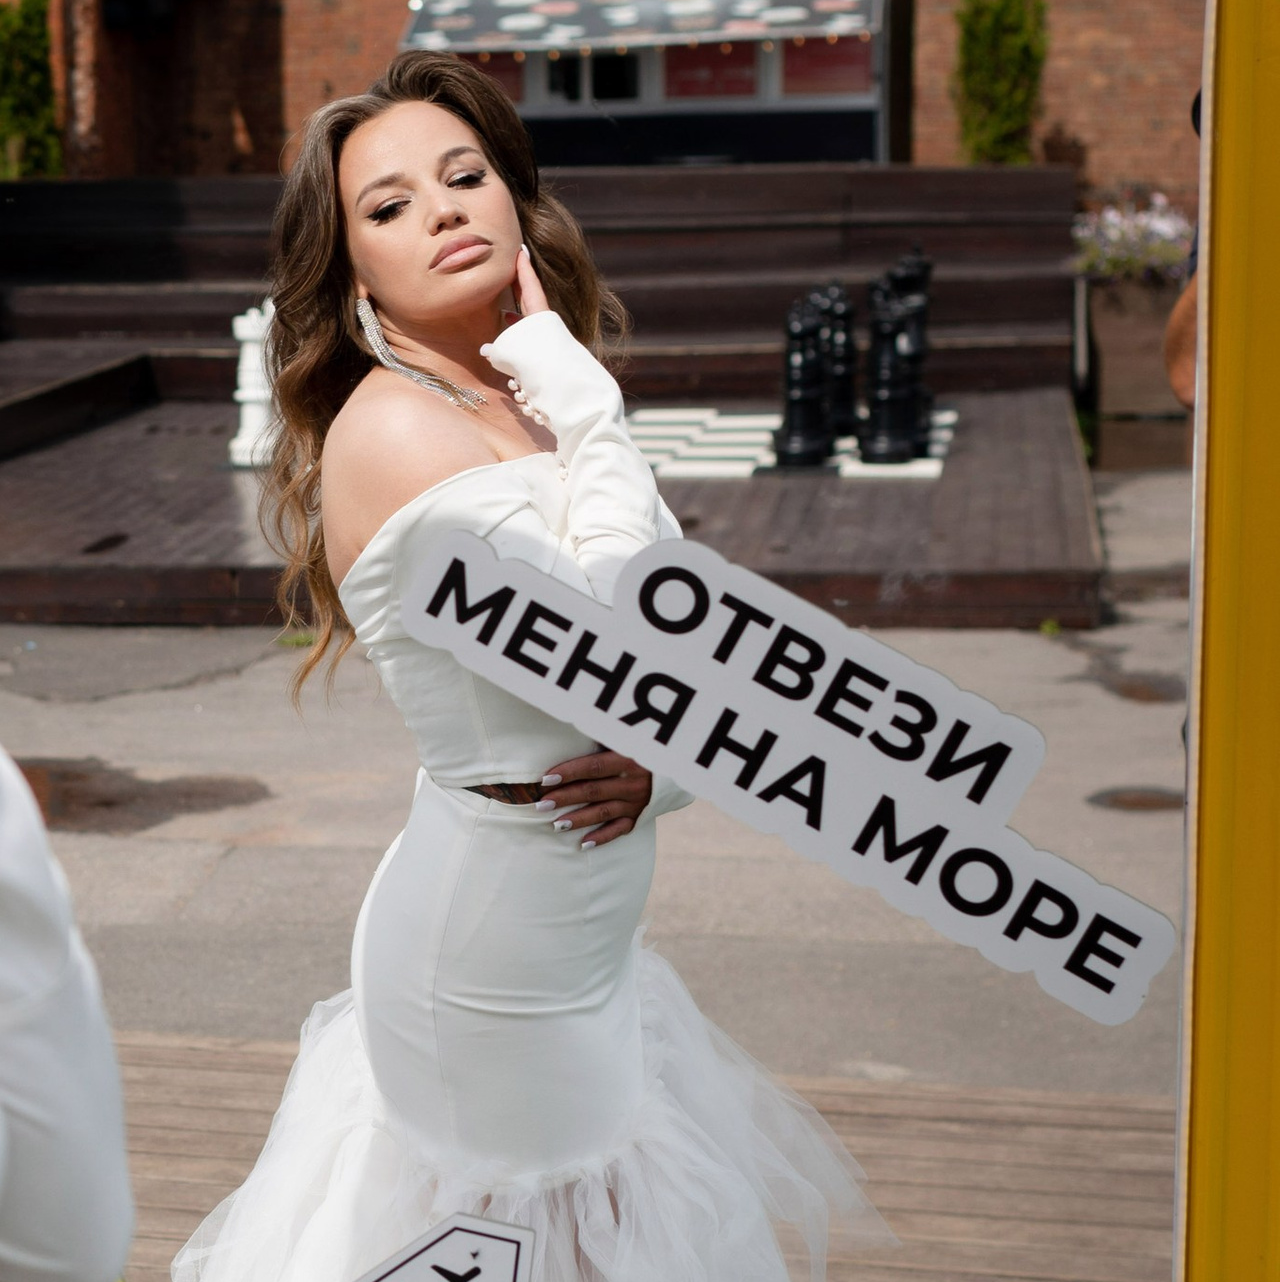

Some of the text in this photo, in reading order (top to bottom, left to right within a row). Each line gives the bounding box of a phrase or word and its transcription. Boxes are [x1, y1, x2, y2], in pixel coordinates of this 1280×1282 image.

[425, 557, 1143, 994] МЕНЯ НА МОРЕ
[638, 566, 1013, 805] ОТВЕЗИ
